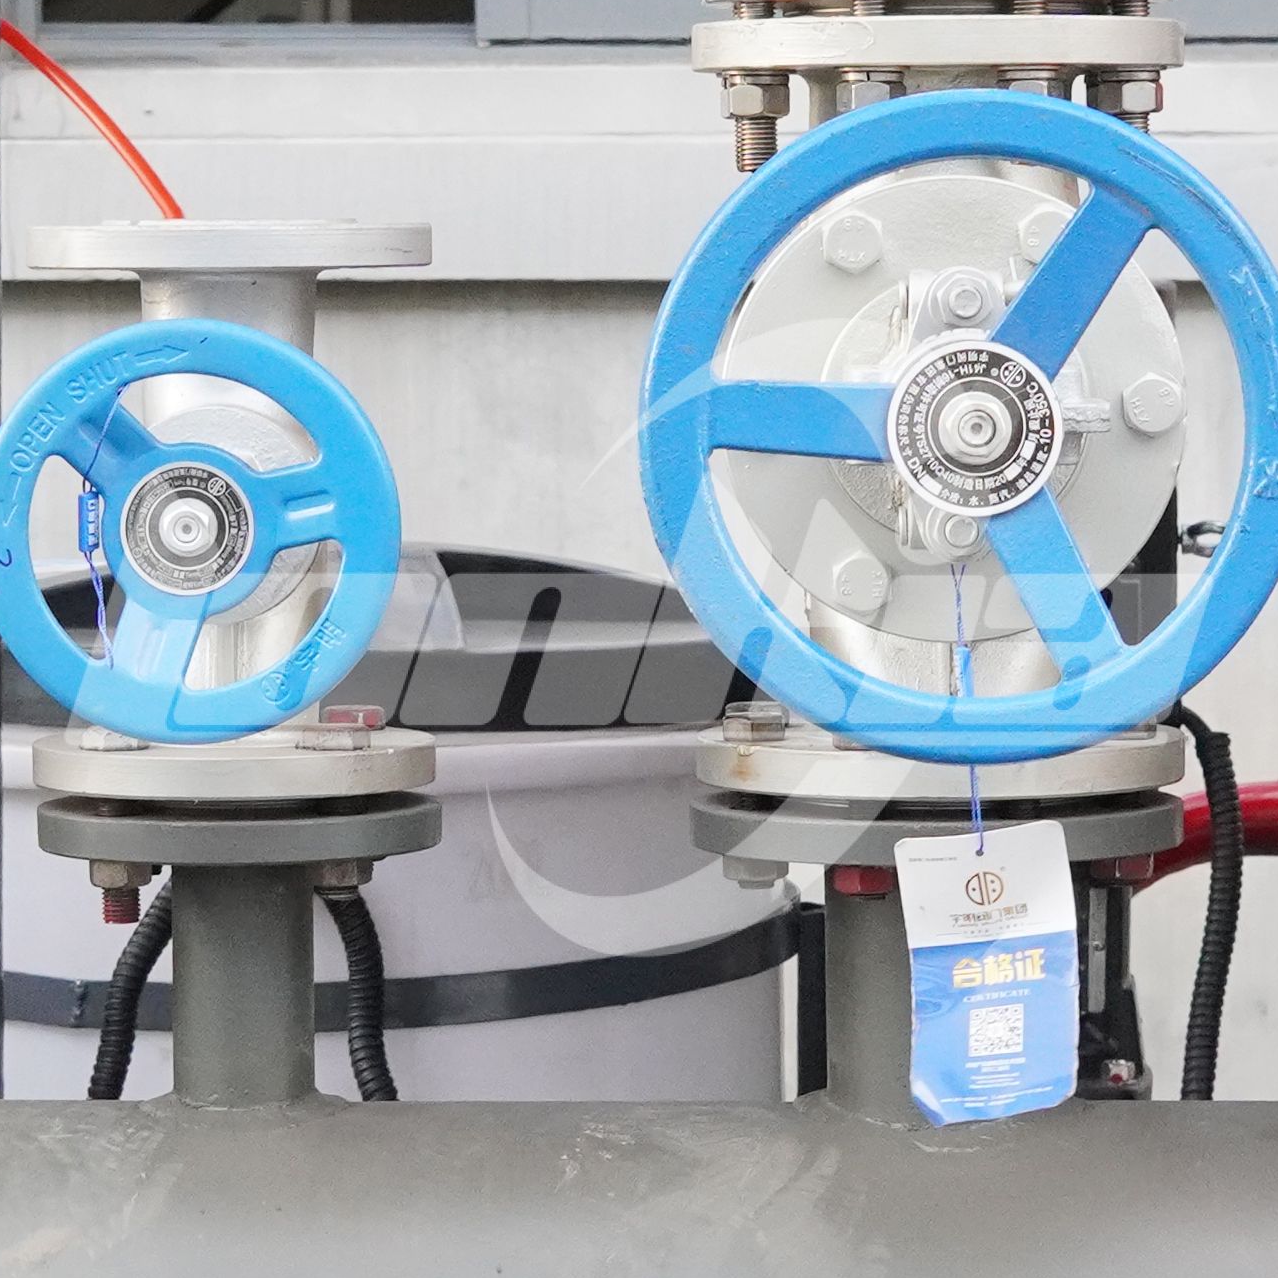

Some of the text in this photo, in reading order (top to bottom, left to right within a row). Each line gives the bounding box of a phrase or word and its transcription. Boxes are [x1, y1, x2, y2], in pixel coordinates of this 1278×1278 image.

[67, 350, 130, 403] SHUT
[11, 402, 67, 471] OPEN
[952, 947, 1047, 989] 合格证
